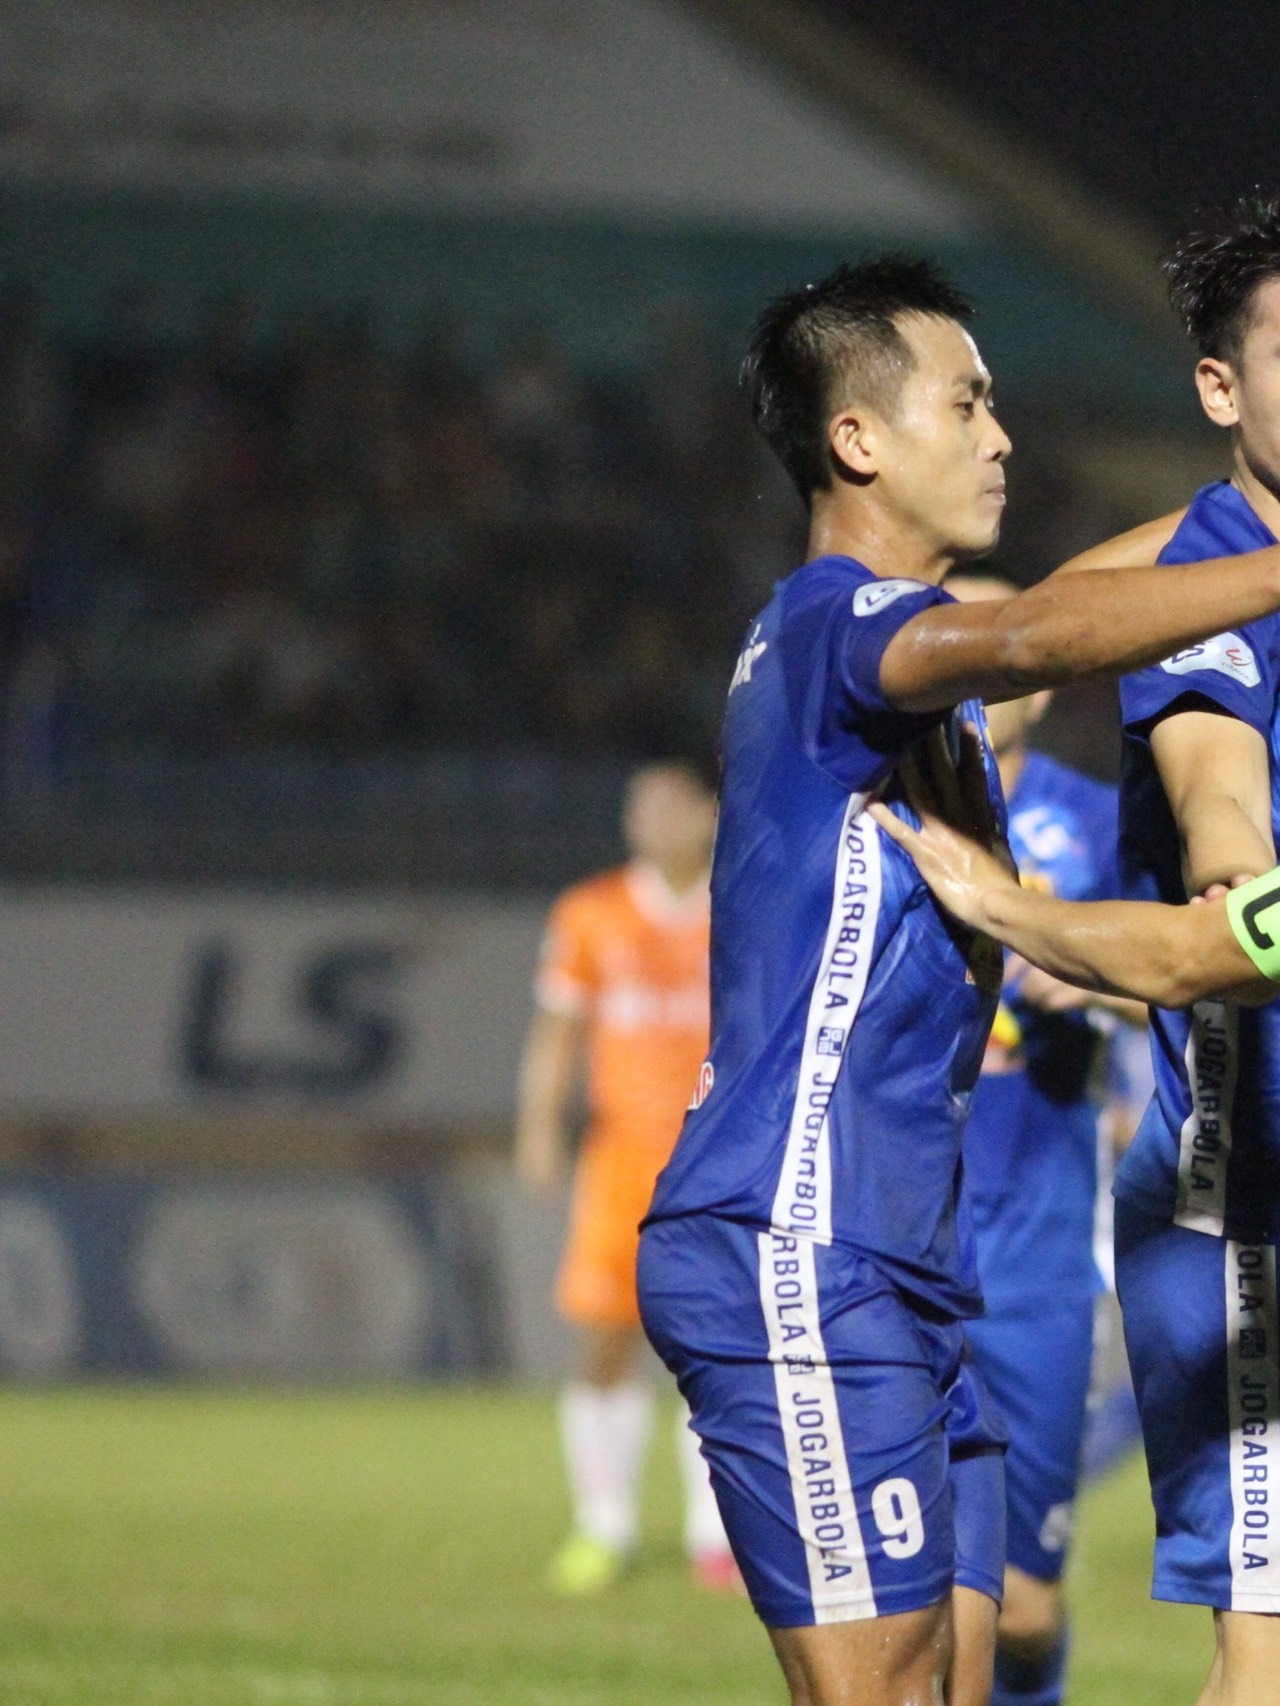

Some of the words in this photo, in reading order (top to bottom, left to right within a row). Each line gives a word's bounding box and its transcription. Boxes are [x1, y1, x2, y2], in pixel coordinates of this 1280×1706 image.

[824, 816, 869, 1010] JOGARBOLA
[174, 932, 408, 1095] LS
[792, 1392, 852, 1582] JOGARBOLA
[871, 1477, 925, 1560] 9
[1240, 1373, 1270, 1571] JOGARBOLA
